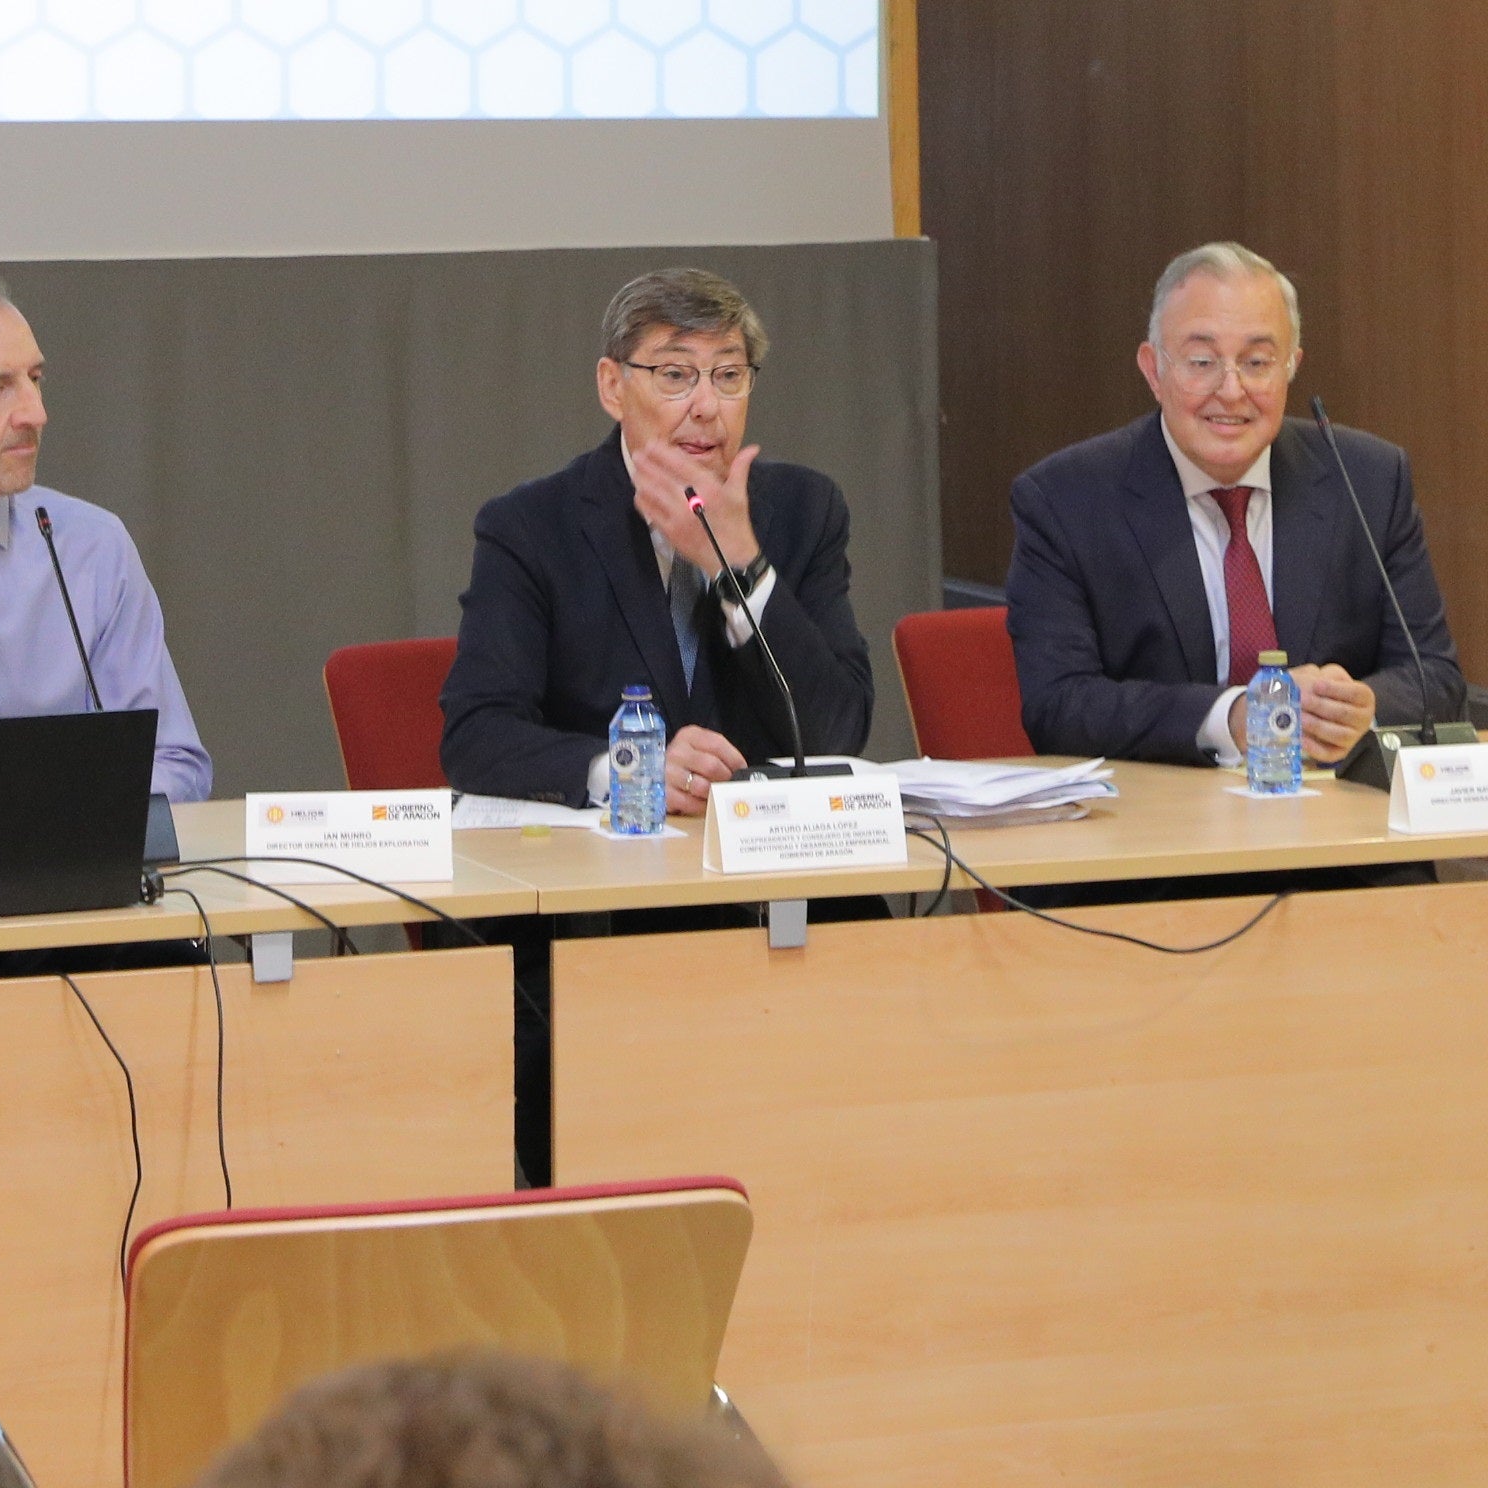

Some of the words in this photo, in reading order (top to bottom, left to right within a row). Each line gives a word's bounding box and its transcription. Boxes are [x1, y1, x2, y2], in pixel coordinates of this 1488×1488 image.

[388, 803, 434, 813] GOBIERNO
[388, 812, 399, 821] DE
[769, 824, 802, 834] ARTURO
[323, 831, 338, 840] IAN
[340, 831, 372, 840] MUNRO
[266, 842, 303, 850] DIRECTOR
[305, 841, 337, 850] GENERAL
